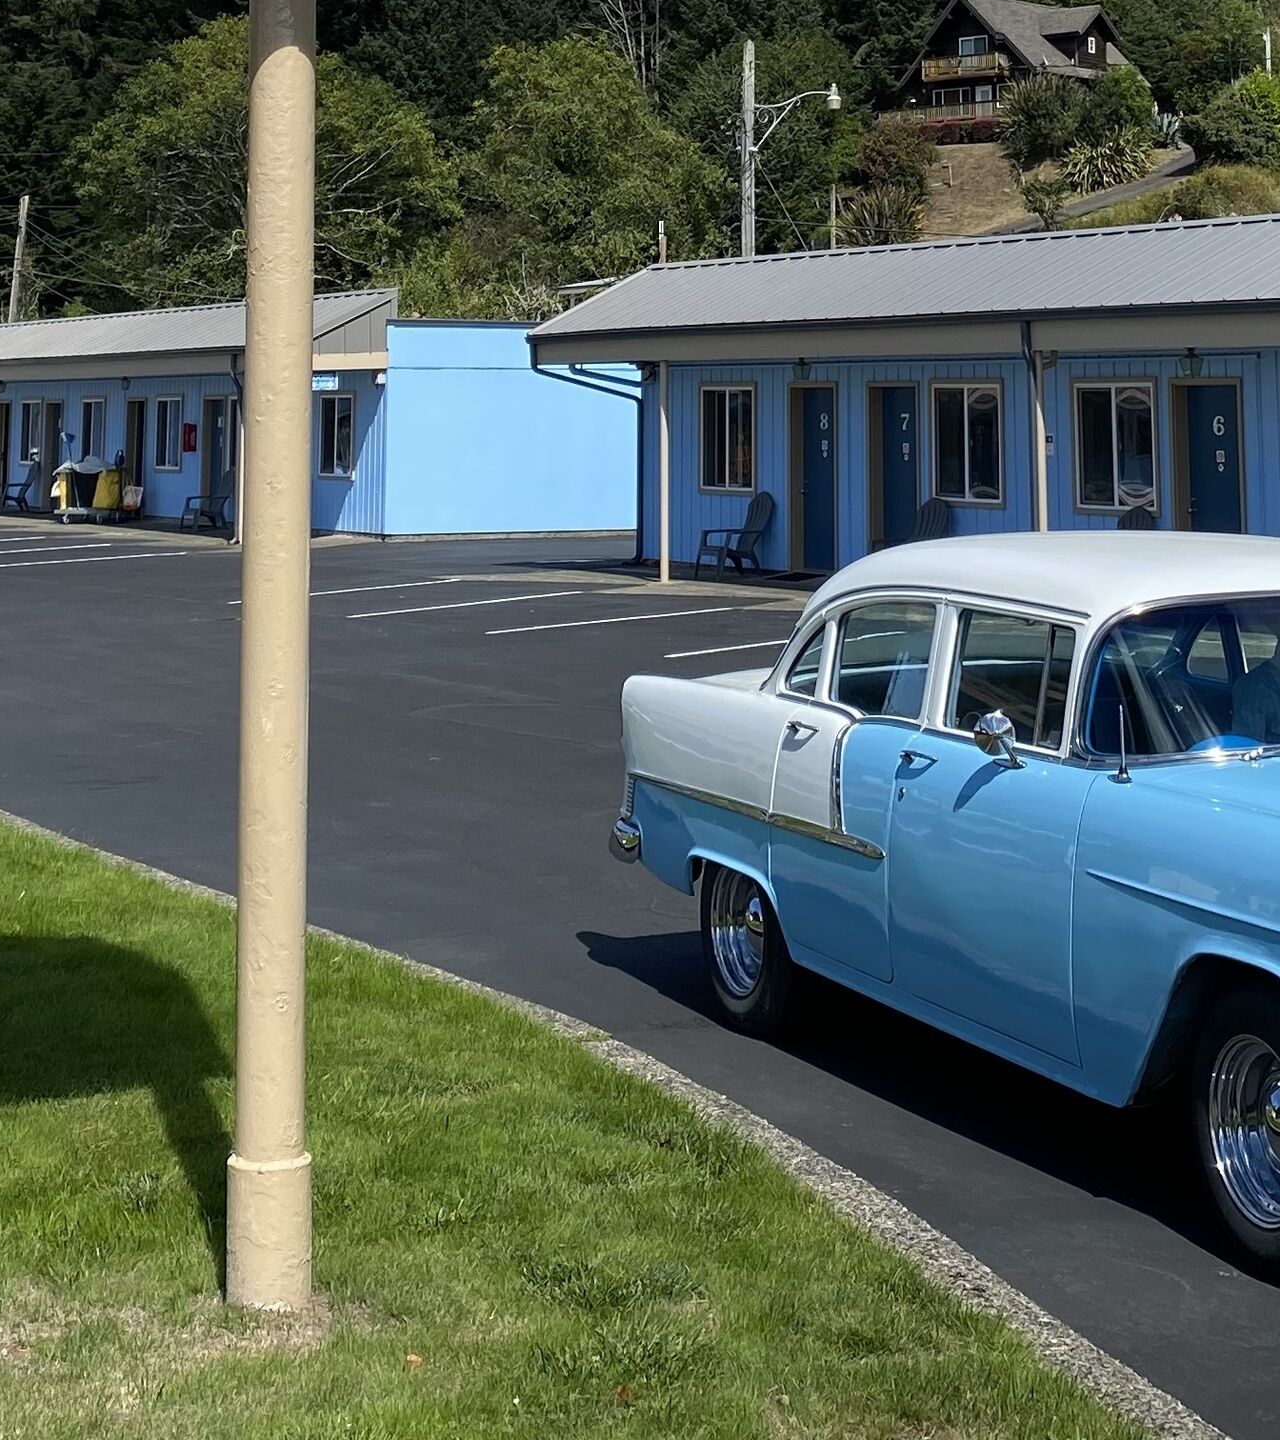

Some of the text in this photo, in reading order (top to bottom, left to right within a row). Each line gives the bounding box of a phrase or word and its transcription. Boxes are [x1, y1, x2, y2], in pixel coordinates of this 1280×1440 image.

[820, 413, 829, 430] 8
[900, 413, 910, 430] 7
[1213, 415, 1225, 436] 6
